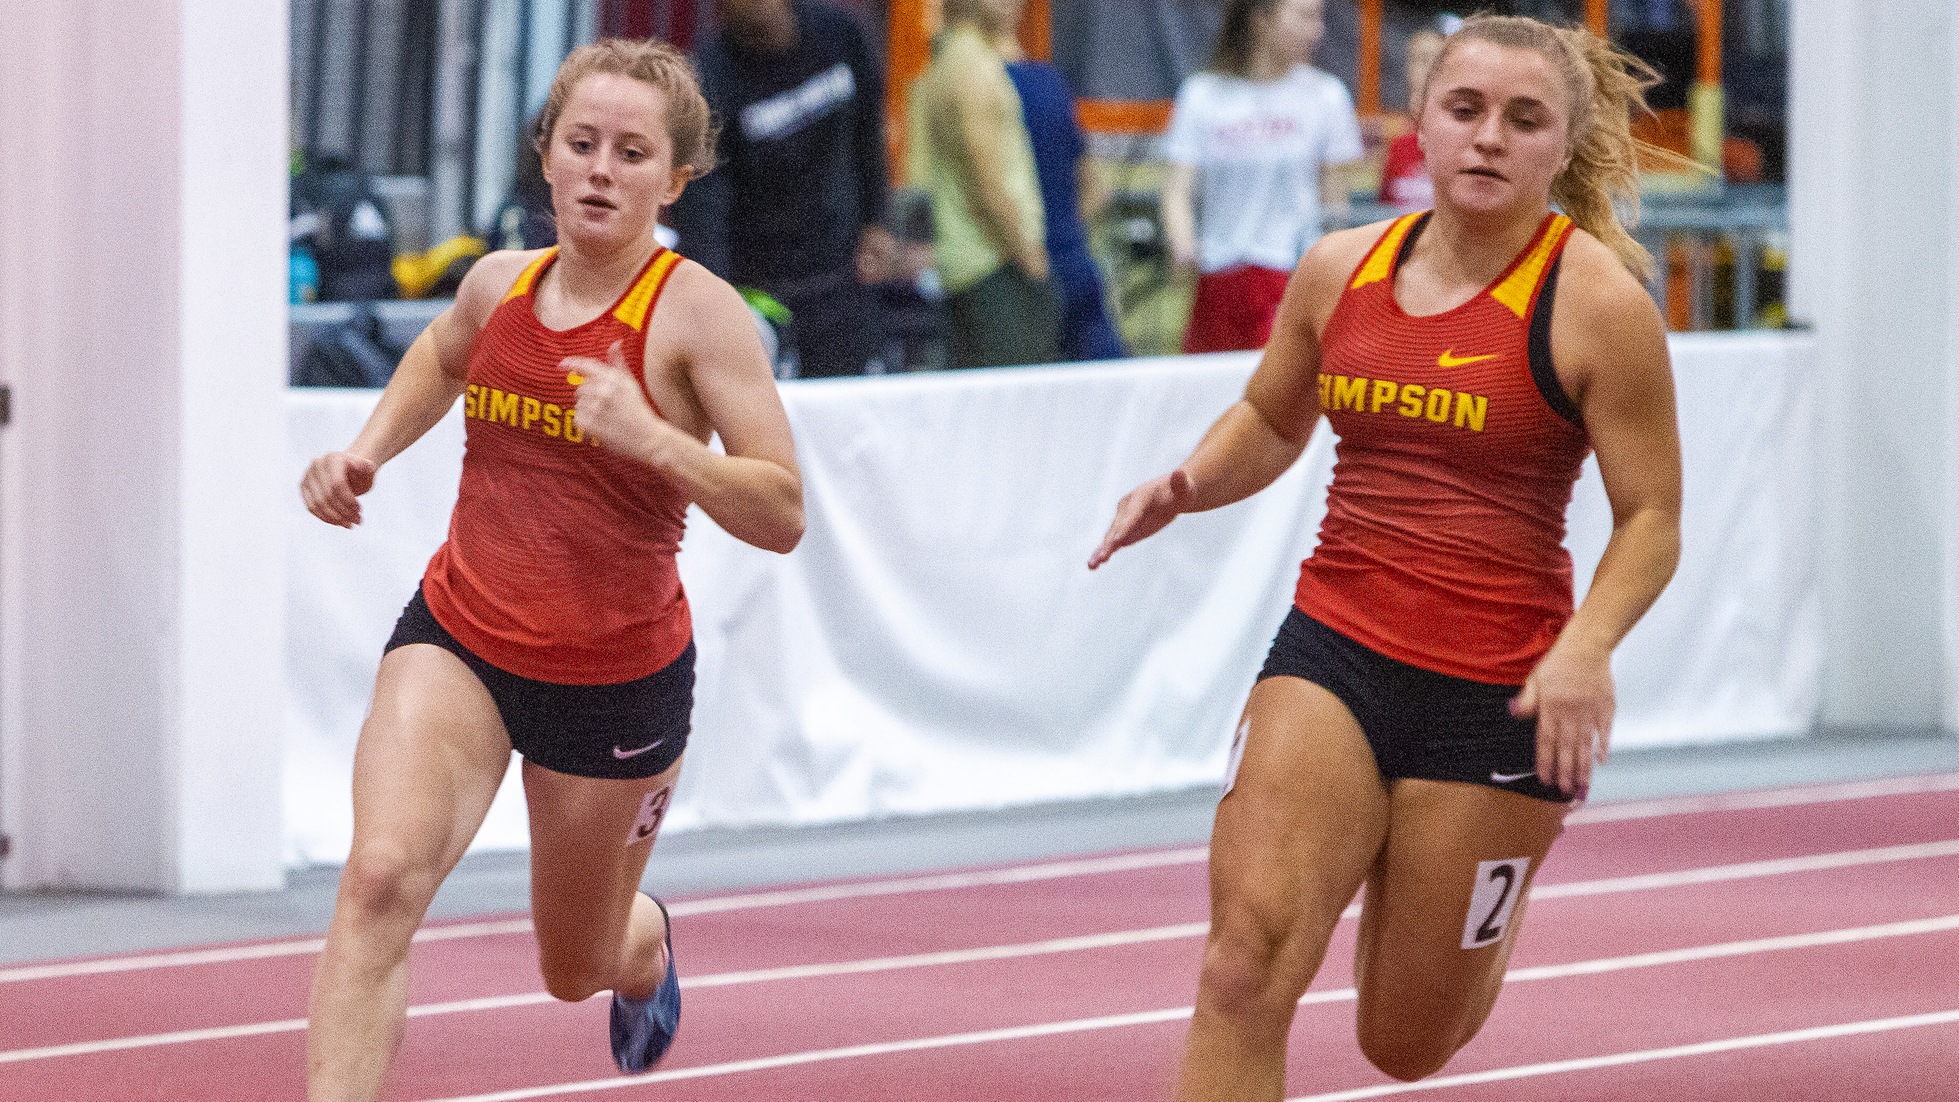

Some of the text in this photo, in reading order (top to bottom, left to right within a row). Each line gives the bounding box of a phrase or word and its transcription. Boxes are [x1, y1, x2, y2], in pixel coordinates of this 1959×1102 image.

[466, 384, 600, 447] SIMPSO
[638, 786, 669, 838] 3
[1475, 864, 1515, 943] 2
